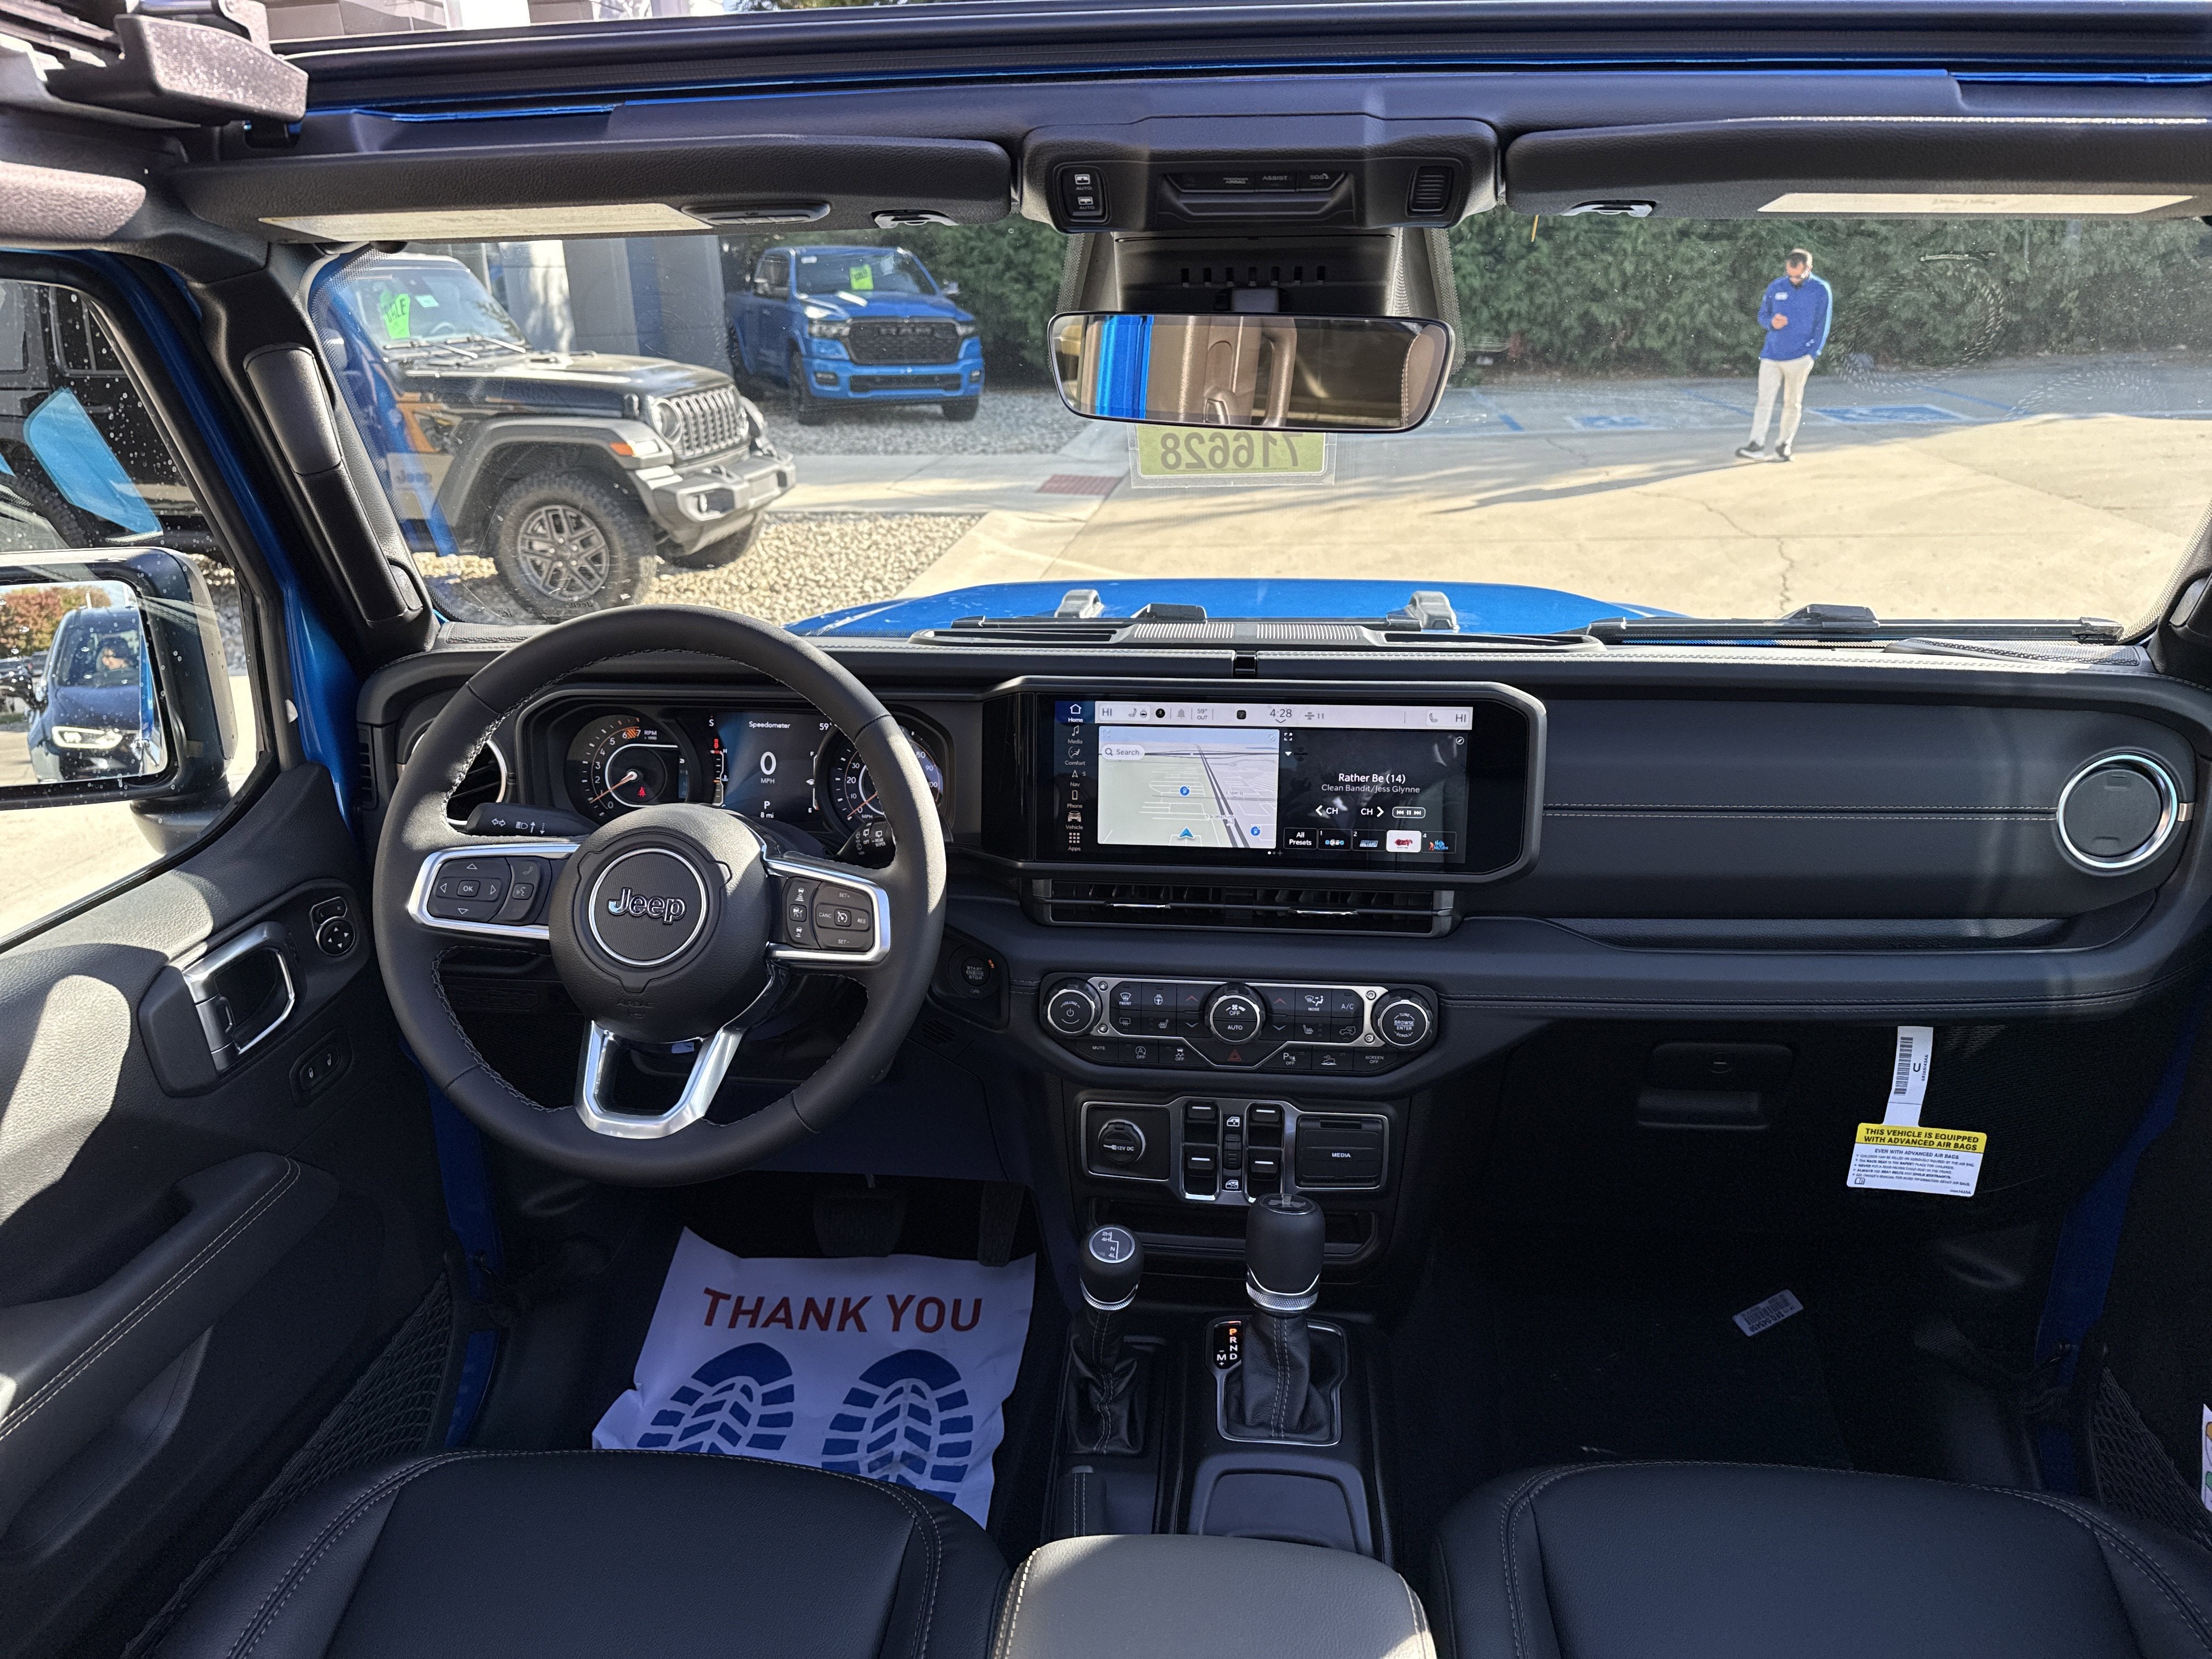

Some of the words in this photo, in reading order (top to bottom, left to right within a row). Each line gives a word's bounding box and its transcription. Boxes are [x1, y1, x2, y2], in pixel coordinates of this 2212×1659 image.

[1270, 708, 1292, 718] 4:28
[1455, 714, 1466, 723] HI
[749, 721, 791, 729] Speedometer
[760, 751, 776, 775] 0
[1339, 774, 1370, 782] Rather
[1372, 774, 1384, 782] Be
[1386, 774, 1406, 784] (14)
[1345, 785, 1390, 793] Bandit/Jess
[1392, 786, 1420, 794] Glynne
[764, 801, 770, 809] P
[608, 888, 685, 924] Jeep
[1887, 1129, 1922, 1138] VEHICLE
[1934, 1133, 1979, 1143] EQUIPPED
[1887, 1137, 1934, 1146] ADVANCED
[703, 1286, 873, 1333] THANK
[887, 1294, 983, 1333] YOU
